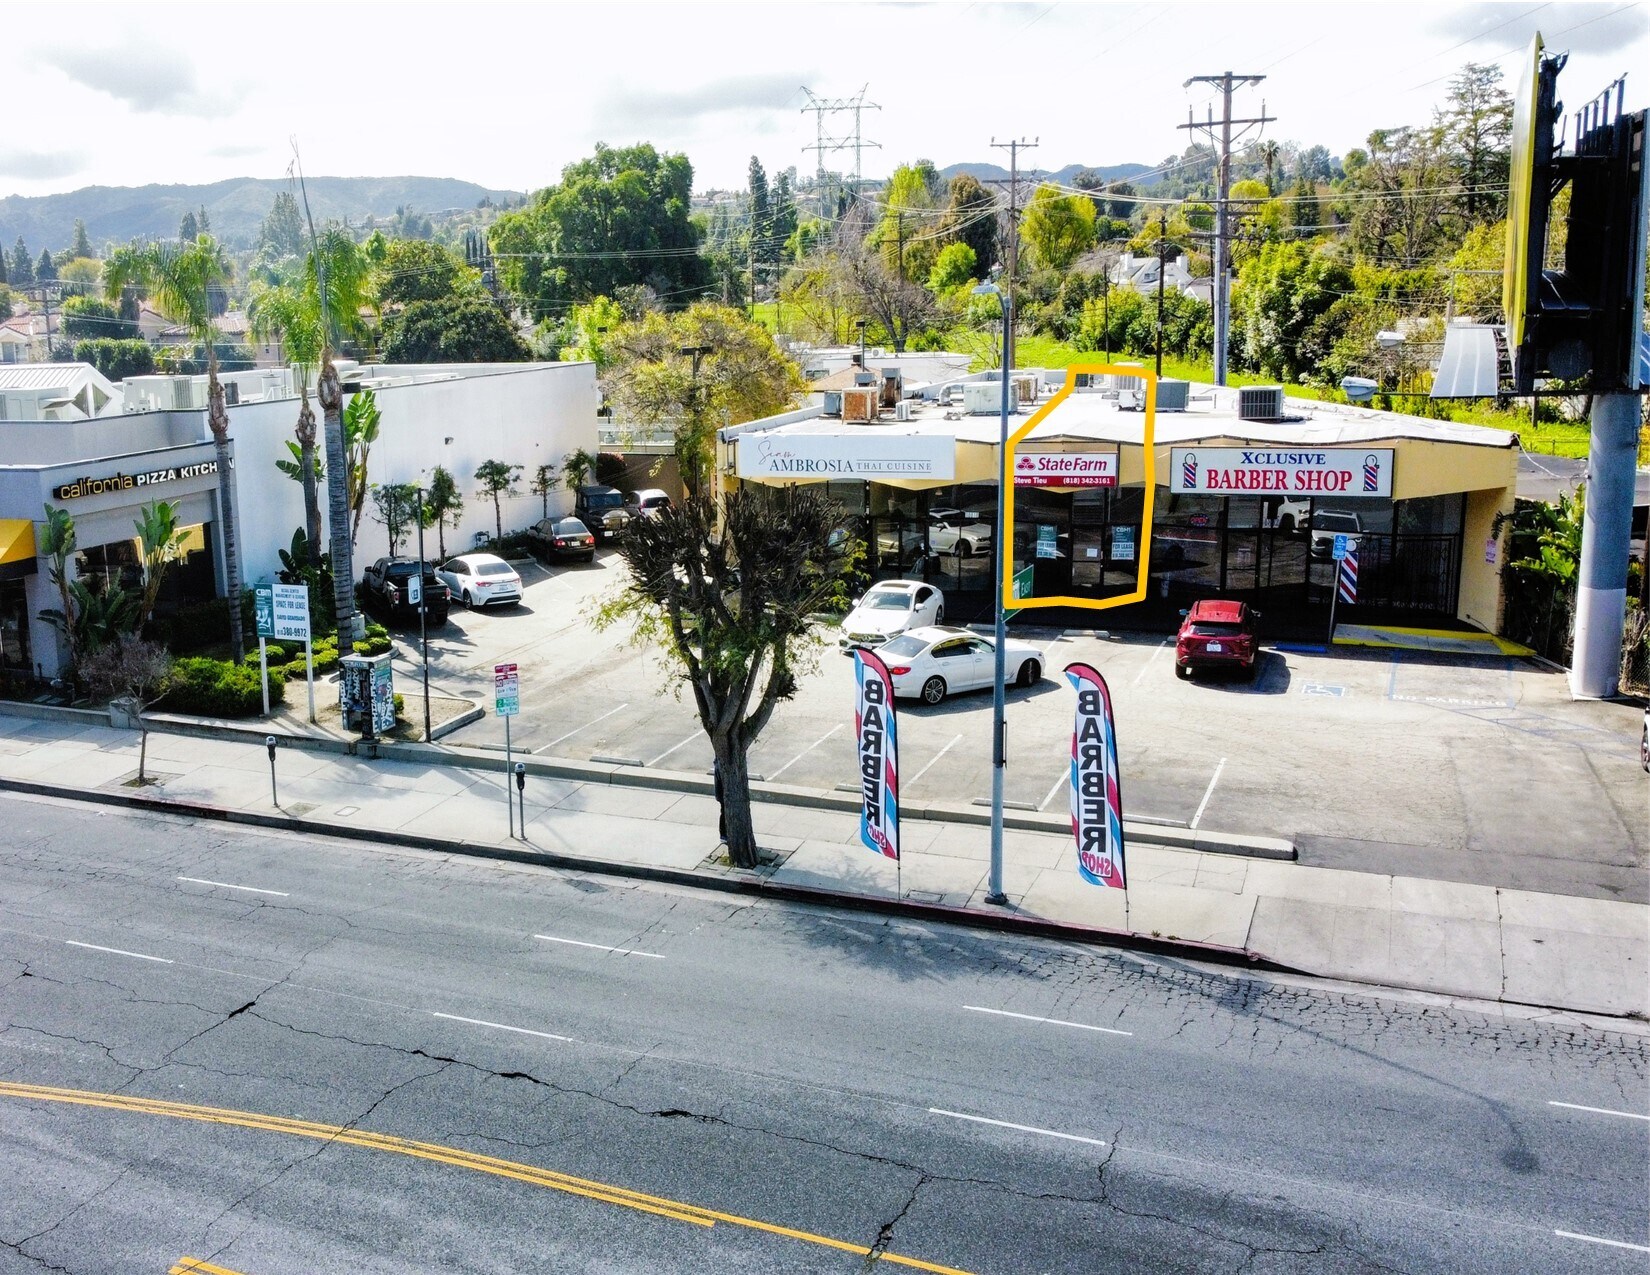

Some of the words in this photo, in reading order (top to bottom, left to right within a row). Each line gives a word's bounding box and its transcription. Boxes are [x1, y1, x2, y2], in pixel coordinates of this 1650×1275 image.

[1241, 451, 1326, 465] XCLUSIVE
[769, 459, 854, 473] AMBROSIA
[857, 462, 882, 471] THAI
[887, 462, 932, 471] CUISINE
[60, 472, 133, 499] california
[136, 469, 176, 487] PIZZA
[180, 458, 235, 479] KITCHN
[1014, 476, 1032, 484] Steve
[1063, 477, 1080, 485] (818)
[1206, 469, 1288, 490] BARBER
[1294, 470, 1353, 491] SHOP
[1425, 696, 1507, 707] PARKING
